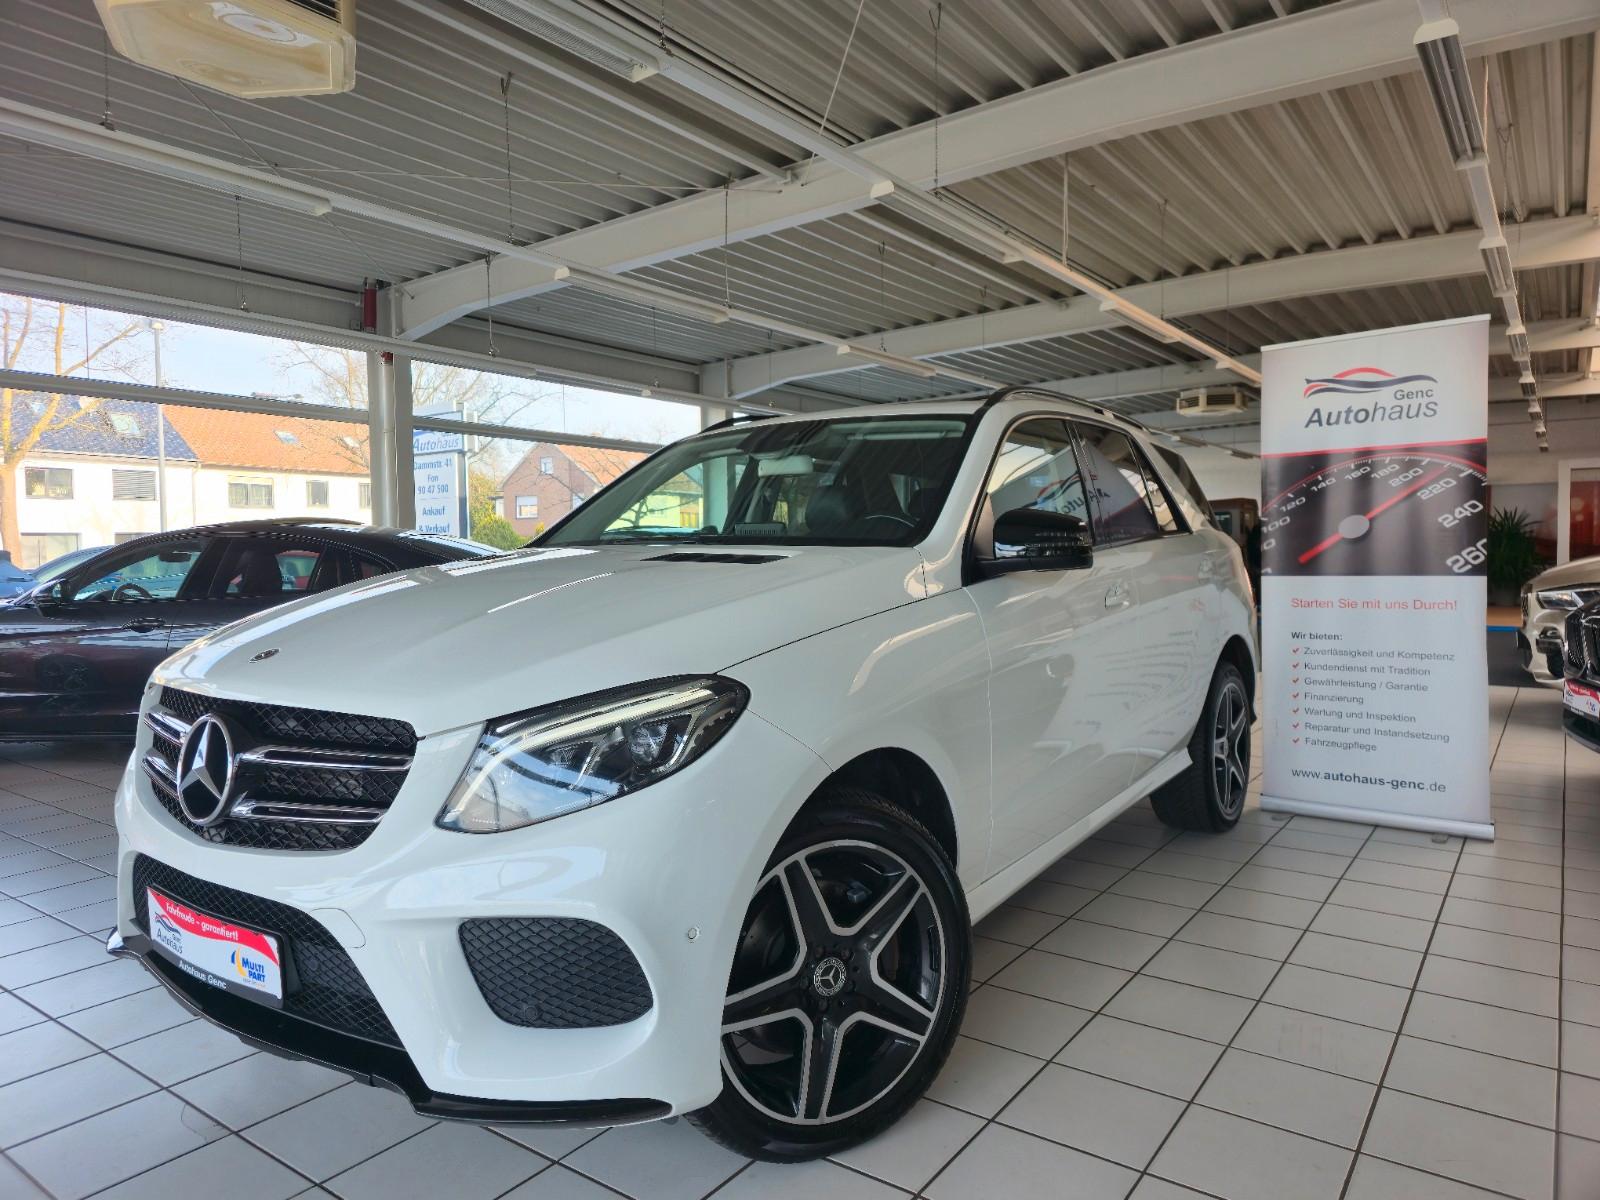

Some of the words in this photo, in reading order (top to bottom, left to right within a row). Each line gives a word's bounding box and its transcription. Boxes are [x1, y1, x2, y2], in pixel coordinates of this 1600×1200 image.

[1394, 388, 1434, 401] Genc
[1304, 401, 1438, 428] Autohaus
[413, 437, 459, 452] Autohaus
[1344, 466, 1371, 480] 160
[1371, 463, 1400, 479] 180
[1388, 467, 1424, 487] 200
[1310, 477, 1337, 492] 140
[1417, 478, 1457, 500] 220
[422, 506, 445, 516] Ankauf
[1280, 496, 1306, 512] 120
[1438, 500, 1484, 528] 240
[425, 523, 450, 533] Verkauf
[1261, 516, 1290, 533] 100
[1291, 598, 1334, 609] Starten
[1338, 599, 1359, 609] Sie
[1362, 599, 1381, 609] mit
[1385, 601, 1409, 610] uns
[1413, 599, 1457, 611] Durch!
[1291, 631, 1306, 640] Wir
[1309, 632, 1343, 641] bieten:
[1304, 647, 1374, 659] Zuverlässigkeit
[1376, 650, 1395, 659] und
[1397, 651, 1455, 662] Kompetenz
[1304, 662, 1368, 673] Kundendienst
[1370, 665, 1385, 674] mit
[1387, 666, 1431, 677] Tradition
[1304, 677, 1377, 690] Gewährleistung
[1385, 681, 1429, 692] Garantie
[1304, 692, 1364, 705] Finanzierung
[1304, 707, 1343, 719] Wartung
[1346, 711, 1363, 719] und
[1366, 711, 1416, 723] Inspektion
[1304, 722, 1351, 733] Reparatur
[1353, 727, 1371, 735] und
[1374, 727, 1450, 743] Instandsetzung
[1305, 737, 1377, 752] Fahrzeugpflege
[1291, 769, 1447, 793] www.autohaus-genc.de
[242, 957, 264, 973] MULTI
[178, 960, 206, 982] Autohaus
[207, 975, 227, 990] Genc
[248, 970, 266, 983] PART
